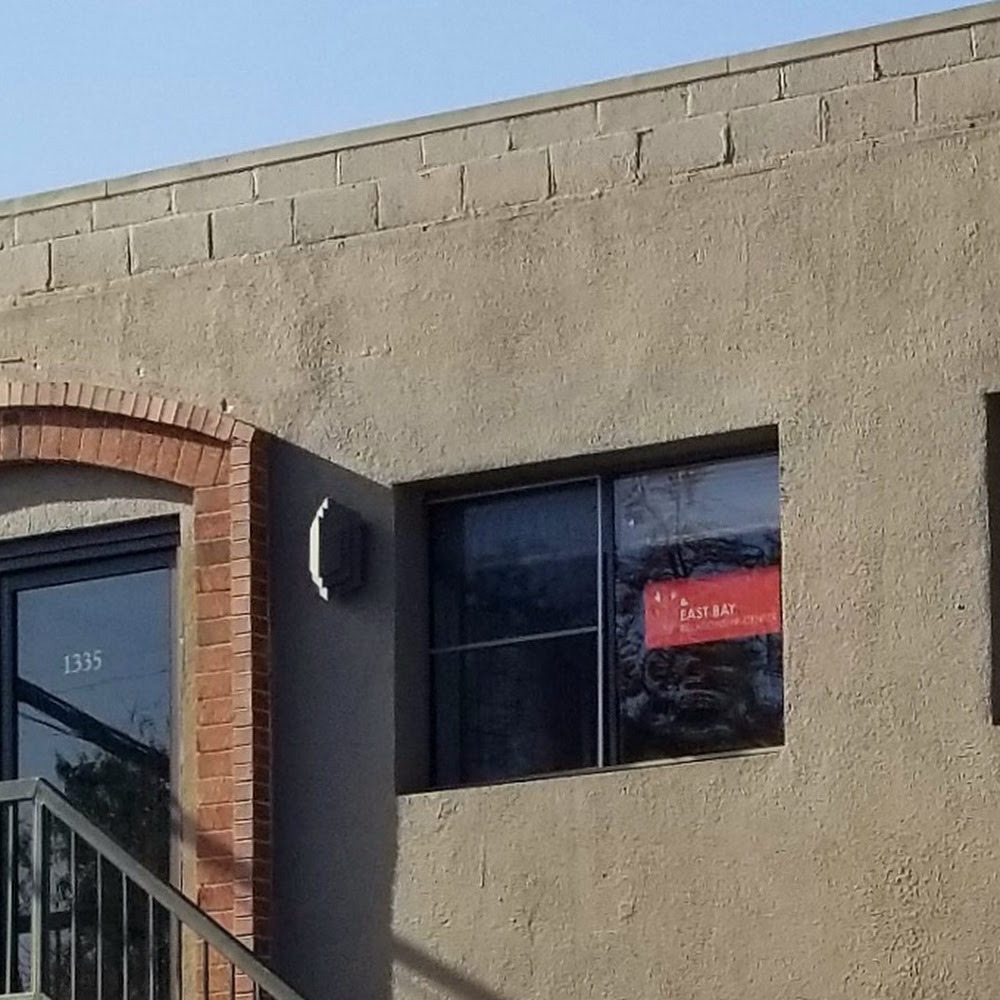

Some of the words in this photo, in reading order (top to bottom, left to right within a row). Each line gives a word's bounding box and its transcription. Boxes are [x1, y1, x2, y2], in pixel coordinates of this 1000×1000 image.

[680, 606, 708, 622] EAST
[712, 603, 737, 618] BAY
[64, 649, 102, 675] 1335
